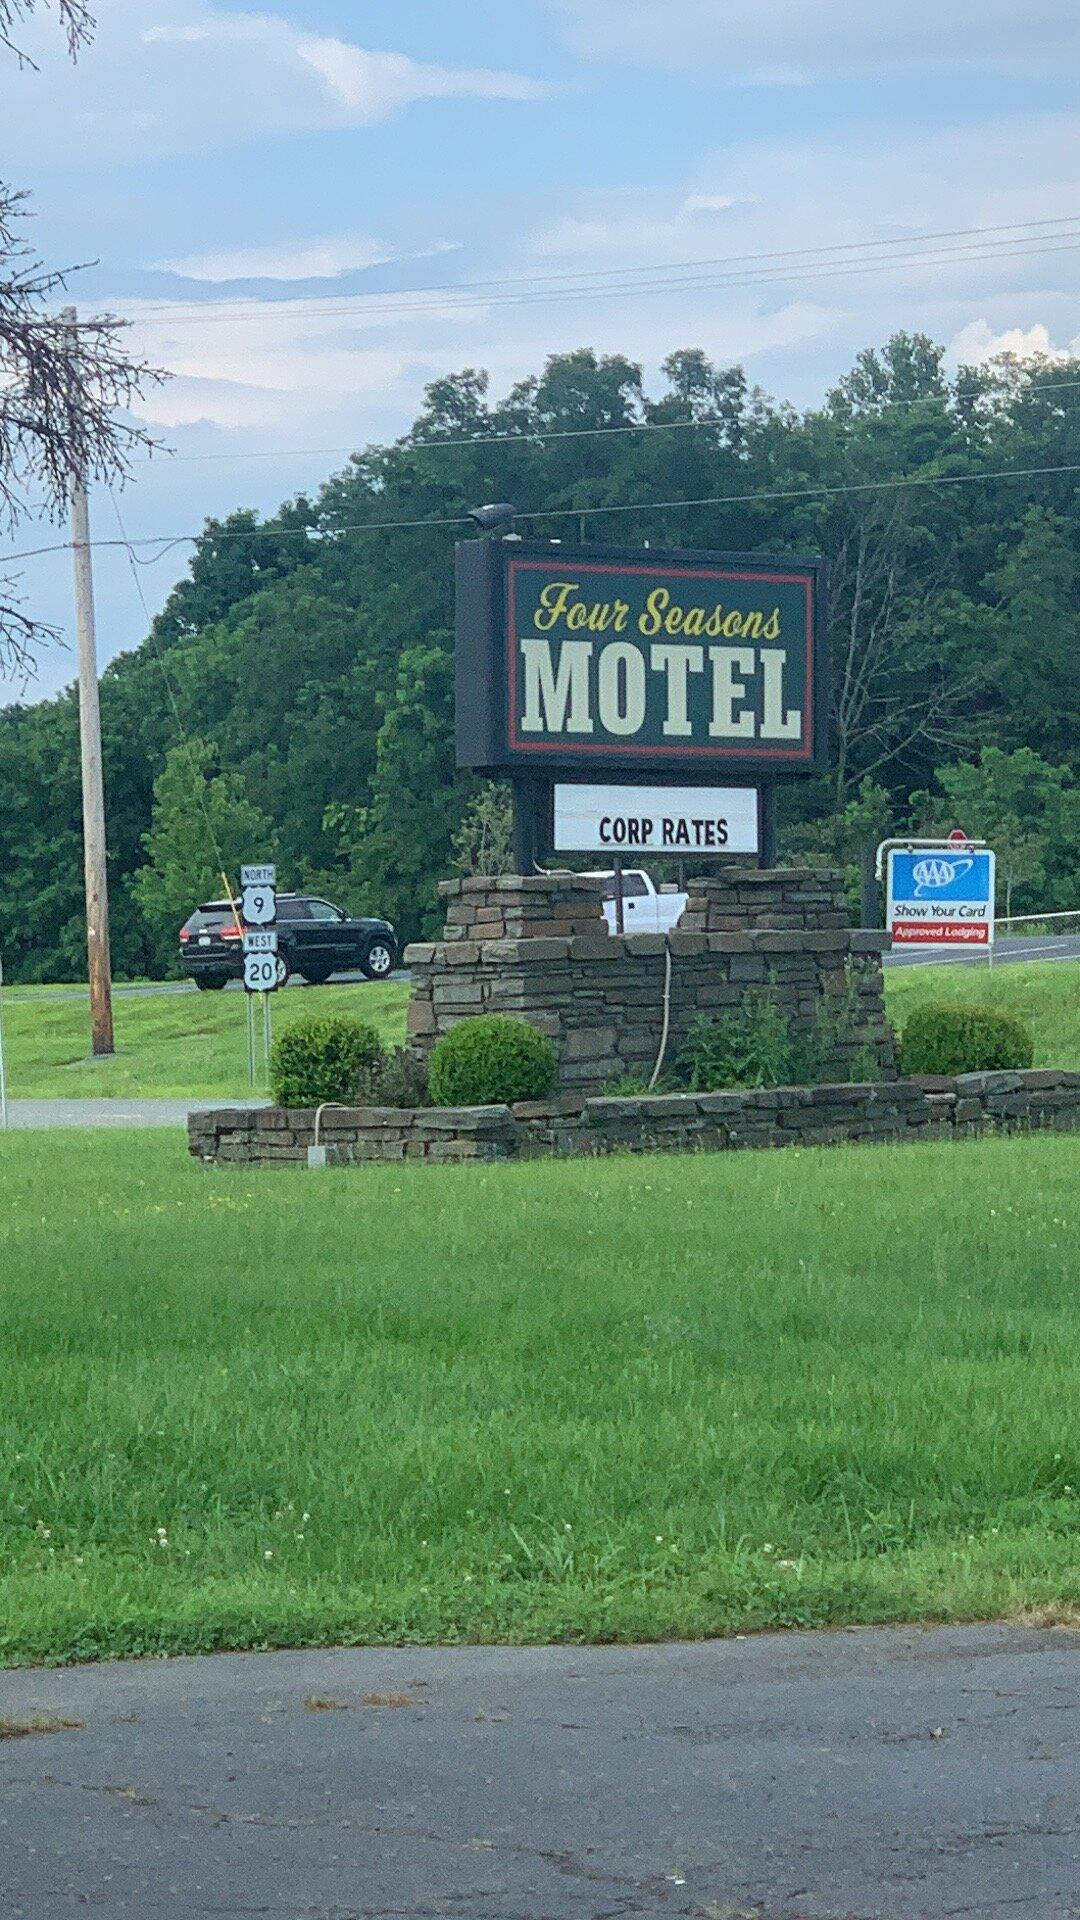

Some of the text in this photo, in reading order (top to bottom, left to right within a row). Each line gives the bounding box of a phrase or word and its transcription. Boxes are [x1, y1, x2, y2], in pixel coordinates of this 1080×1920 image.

[533, 582, 781, 640] Four Seasons
[520, 638, 802, 739] MOTEL
[599, 816, 728, 846] CORP RATES
[243, 869, 274, 880] NORTH
[913, 859, 955, 888] AAA
[253, 897, 264, 914] 9
[894, 904, 986, 917] Show Your Card
[246, 935, 272, 947] WEST
[895, 927, 986, 939] Approved Lodging
[249, 963, 273, 981] 20
